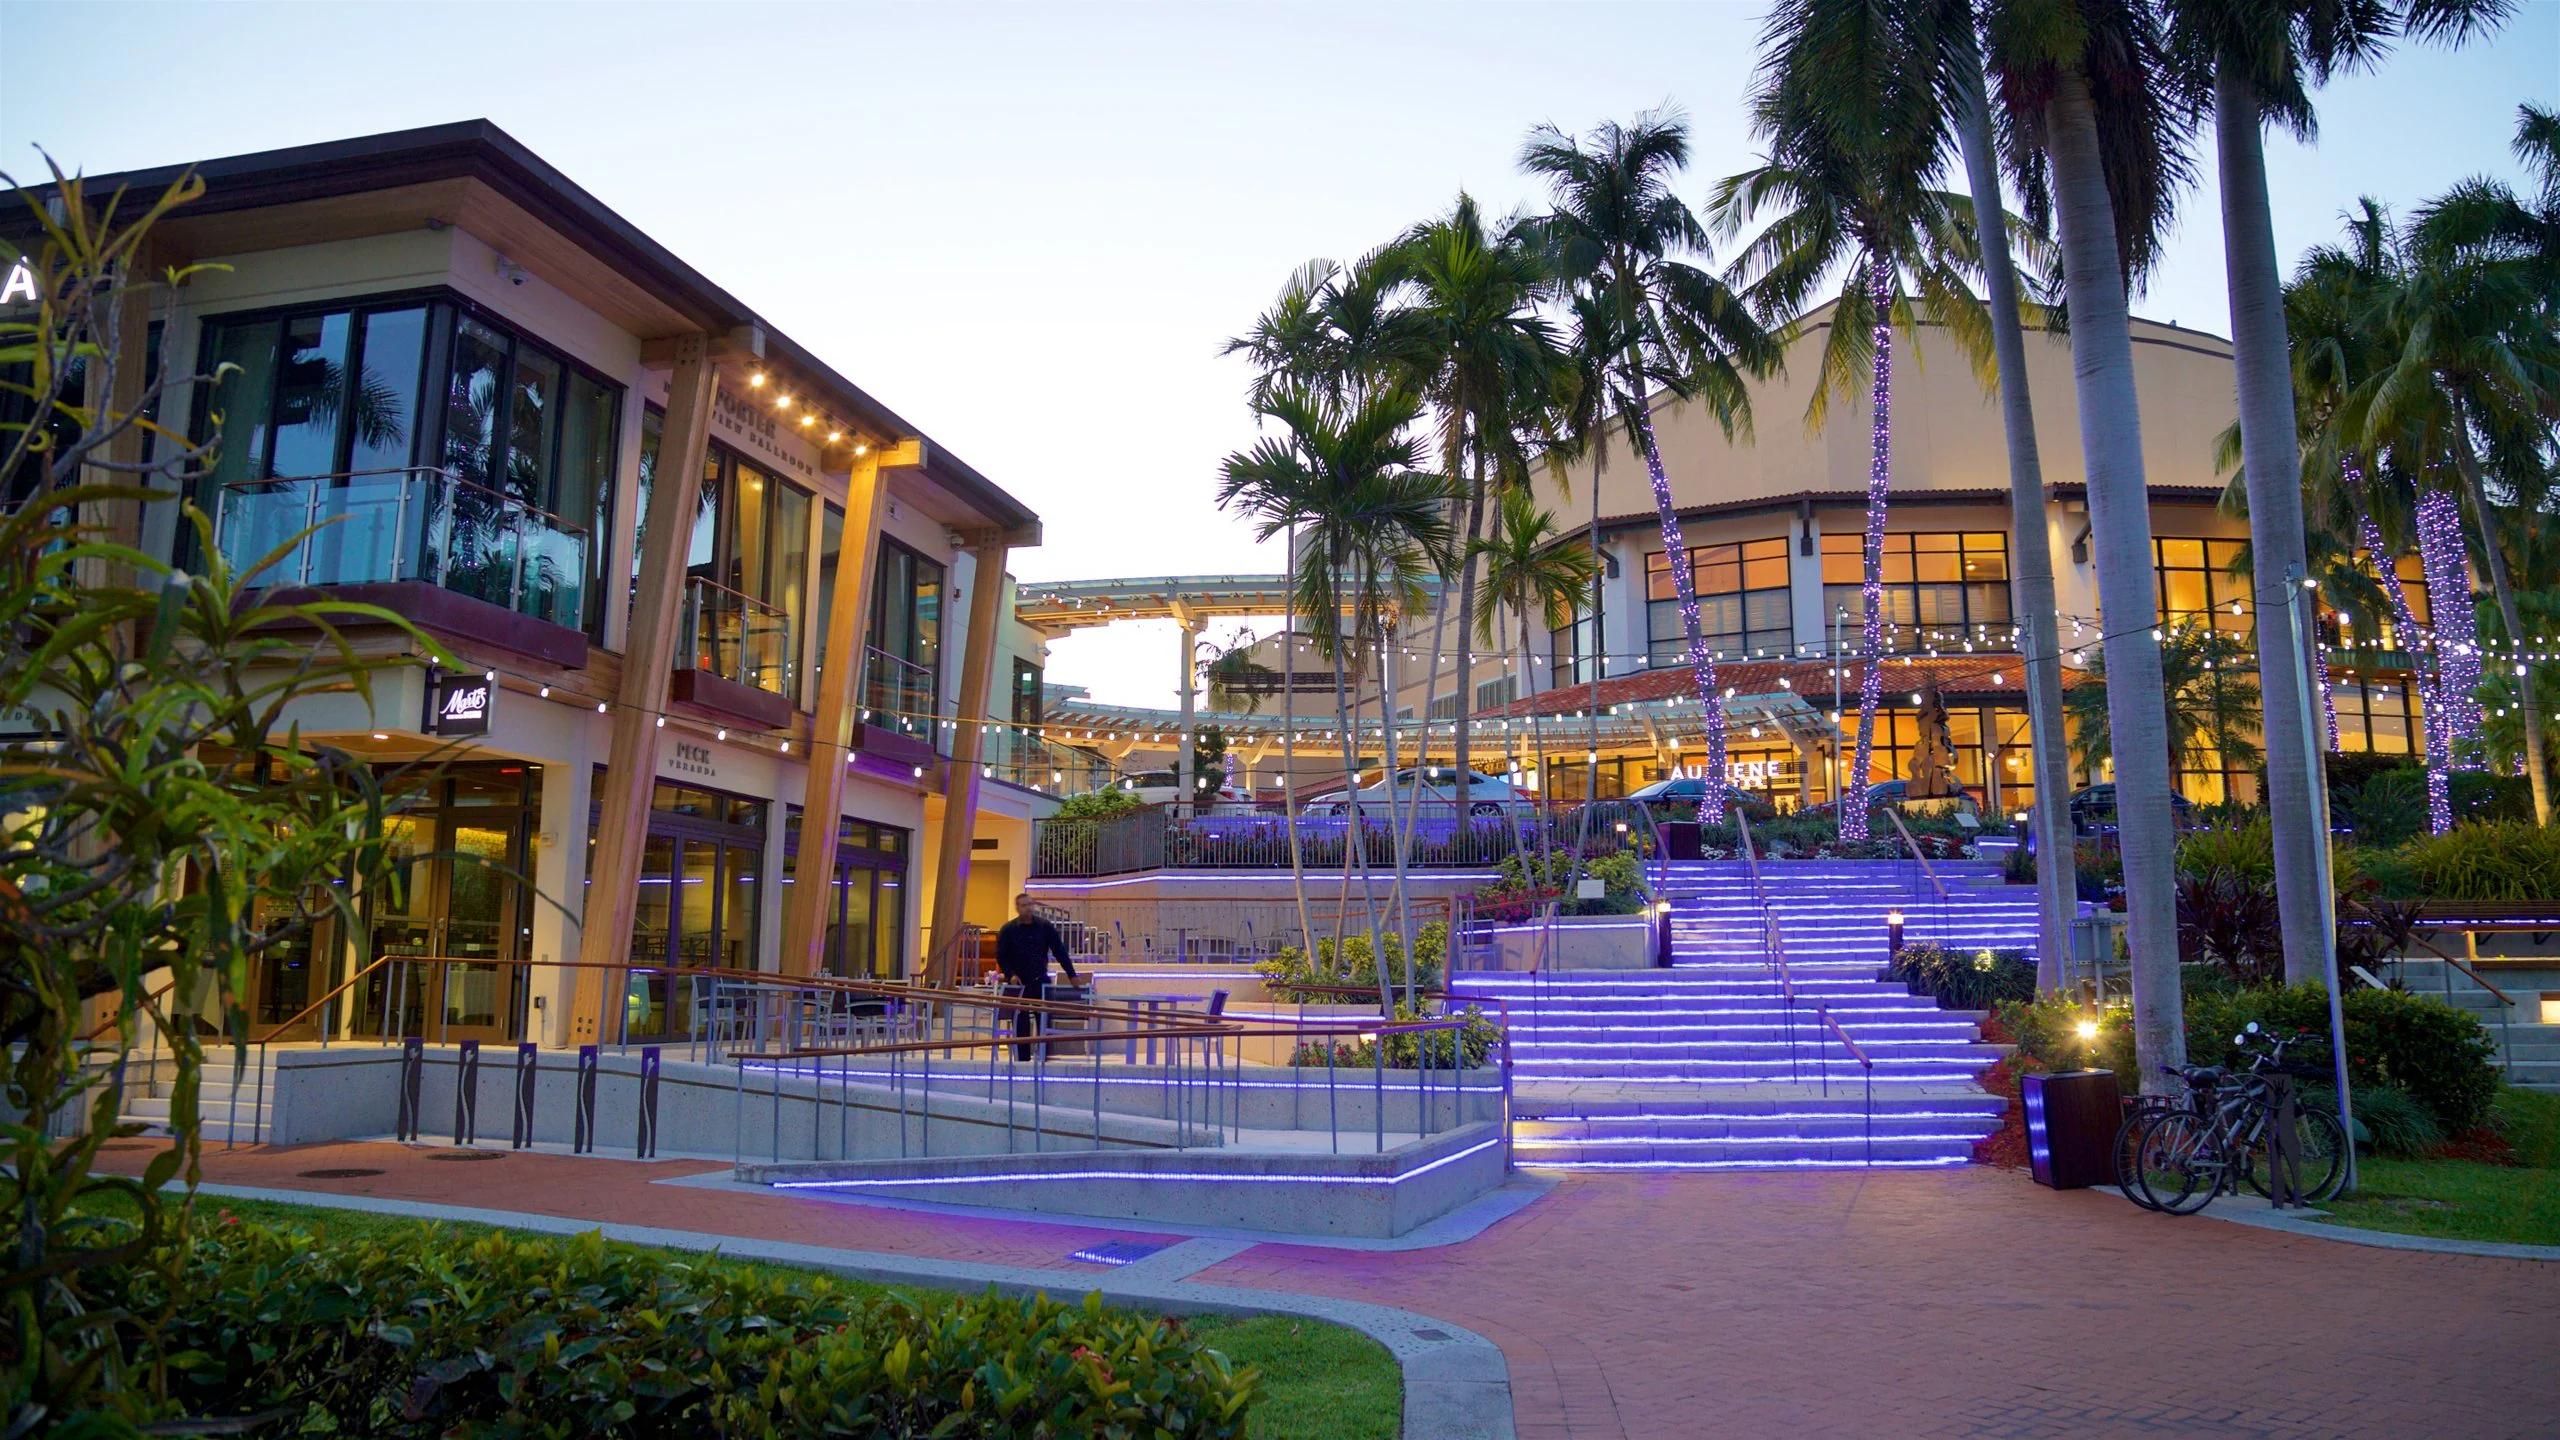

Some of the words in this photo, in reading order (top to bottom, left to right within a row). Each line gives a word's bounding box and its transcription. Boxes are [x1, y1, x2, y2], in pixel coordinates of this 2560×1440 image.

[0, 256, 37, 304] A
[750, 432, 813, 476] BALLROOM
[677, 741, 710, 765] PECK
